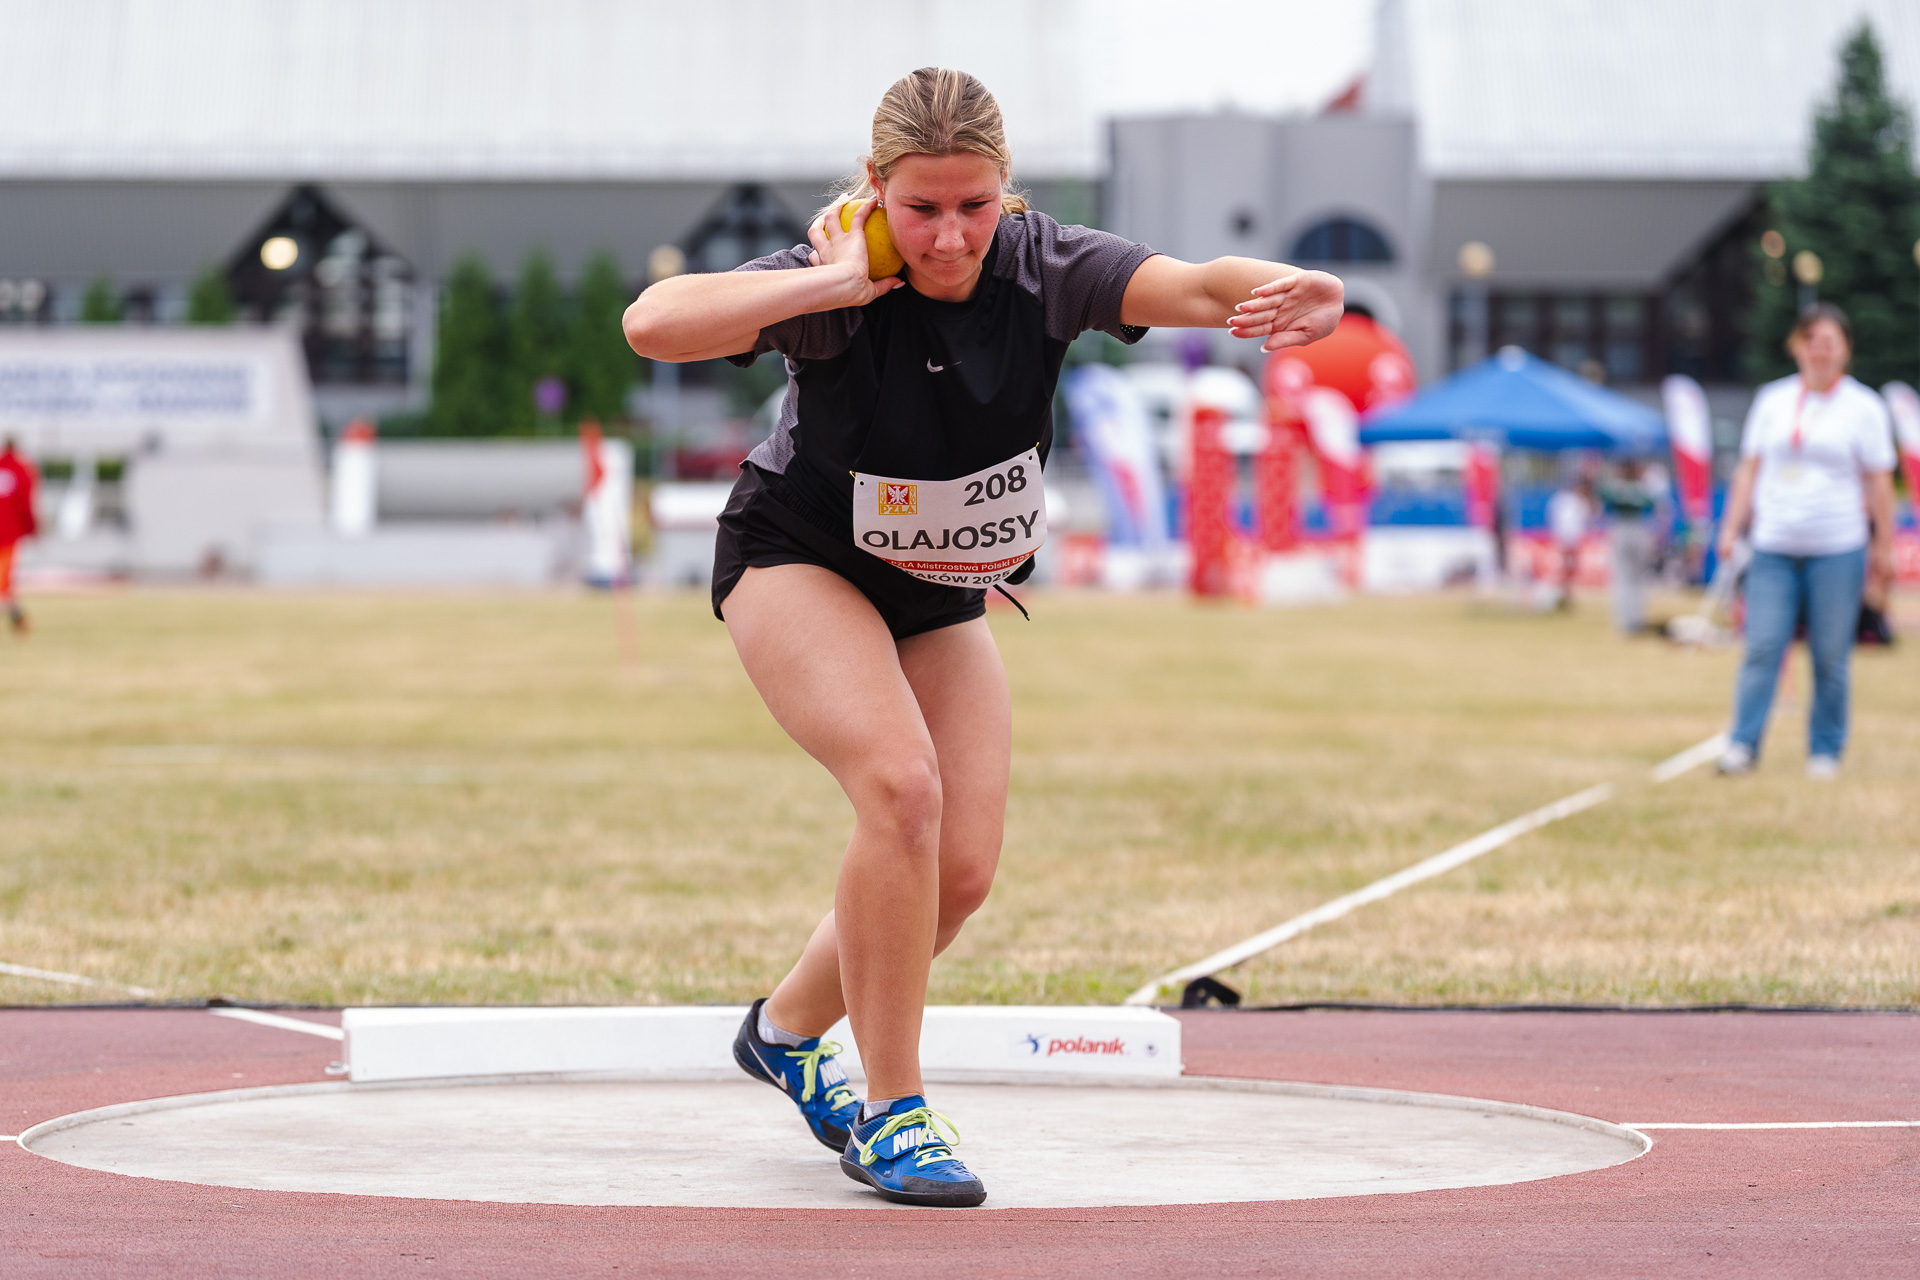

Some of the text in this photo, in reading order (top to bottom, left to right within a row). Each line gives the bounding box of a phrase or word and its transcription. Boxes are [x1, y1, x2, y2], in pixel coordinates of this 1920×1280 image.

[964, 465, 1027, 506] 208
[880, 504, 916, 514] PZLA
[862, 510, 1039, 550] OLAJOSSY
[916, 562, 979, 572] Mistrzostwa
[981, 559, 1010, 571] Polski
[972, 570, 1011, 584] 2025
[1047, 1035, 1126, 1056] polanik
[819, 1059, 847, 1088] NIK
[893, 1127, 941, 1155] NIKE
